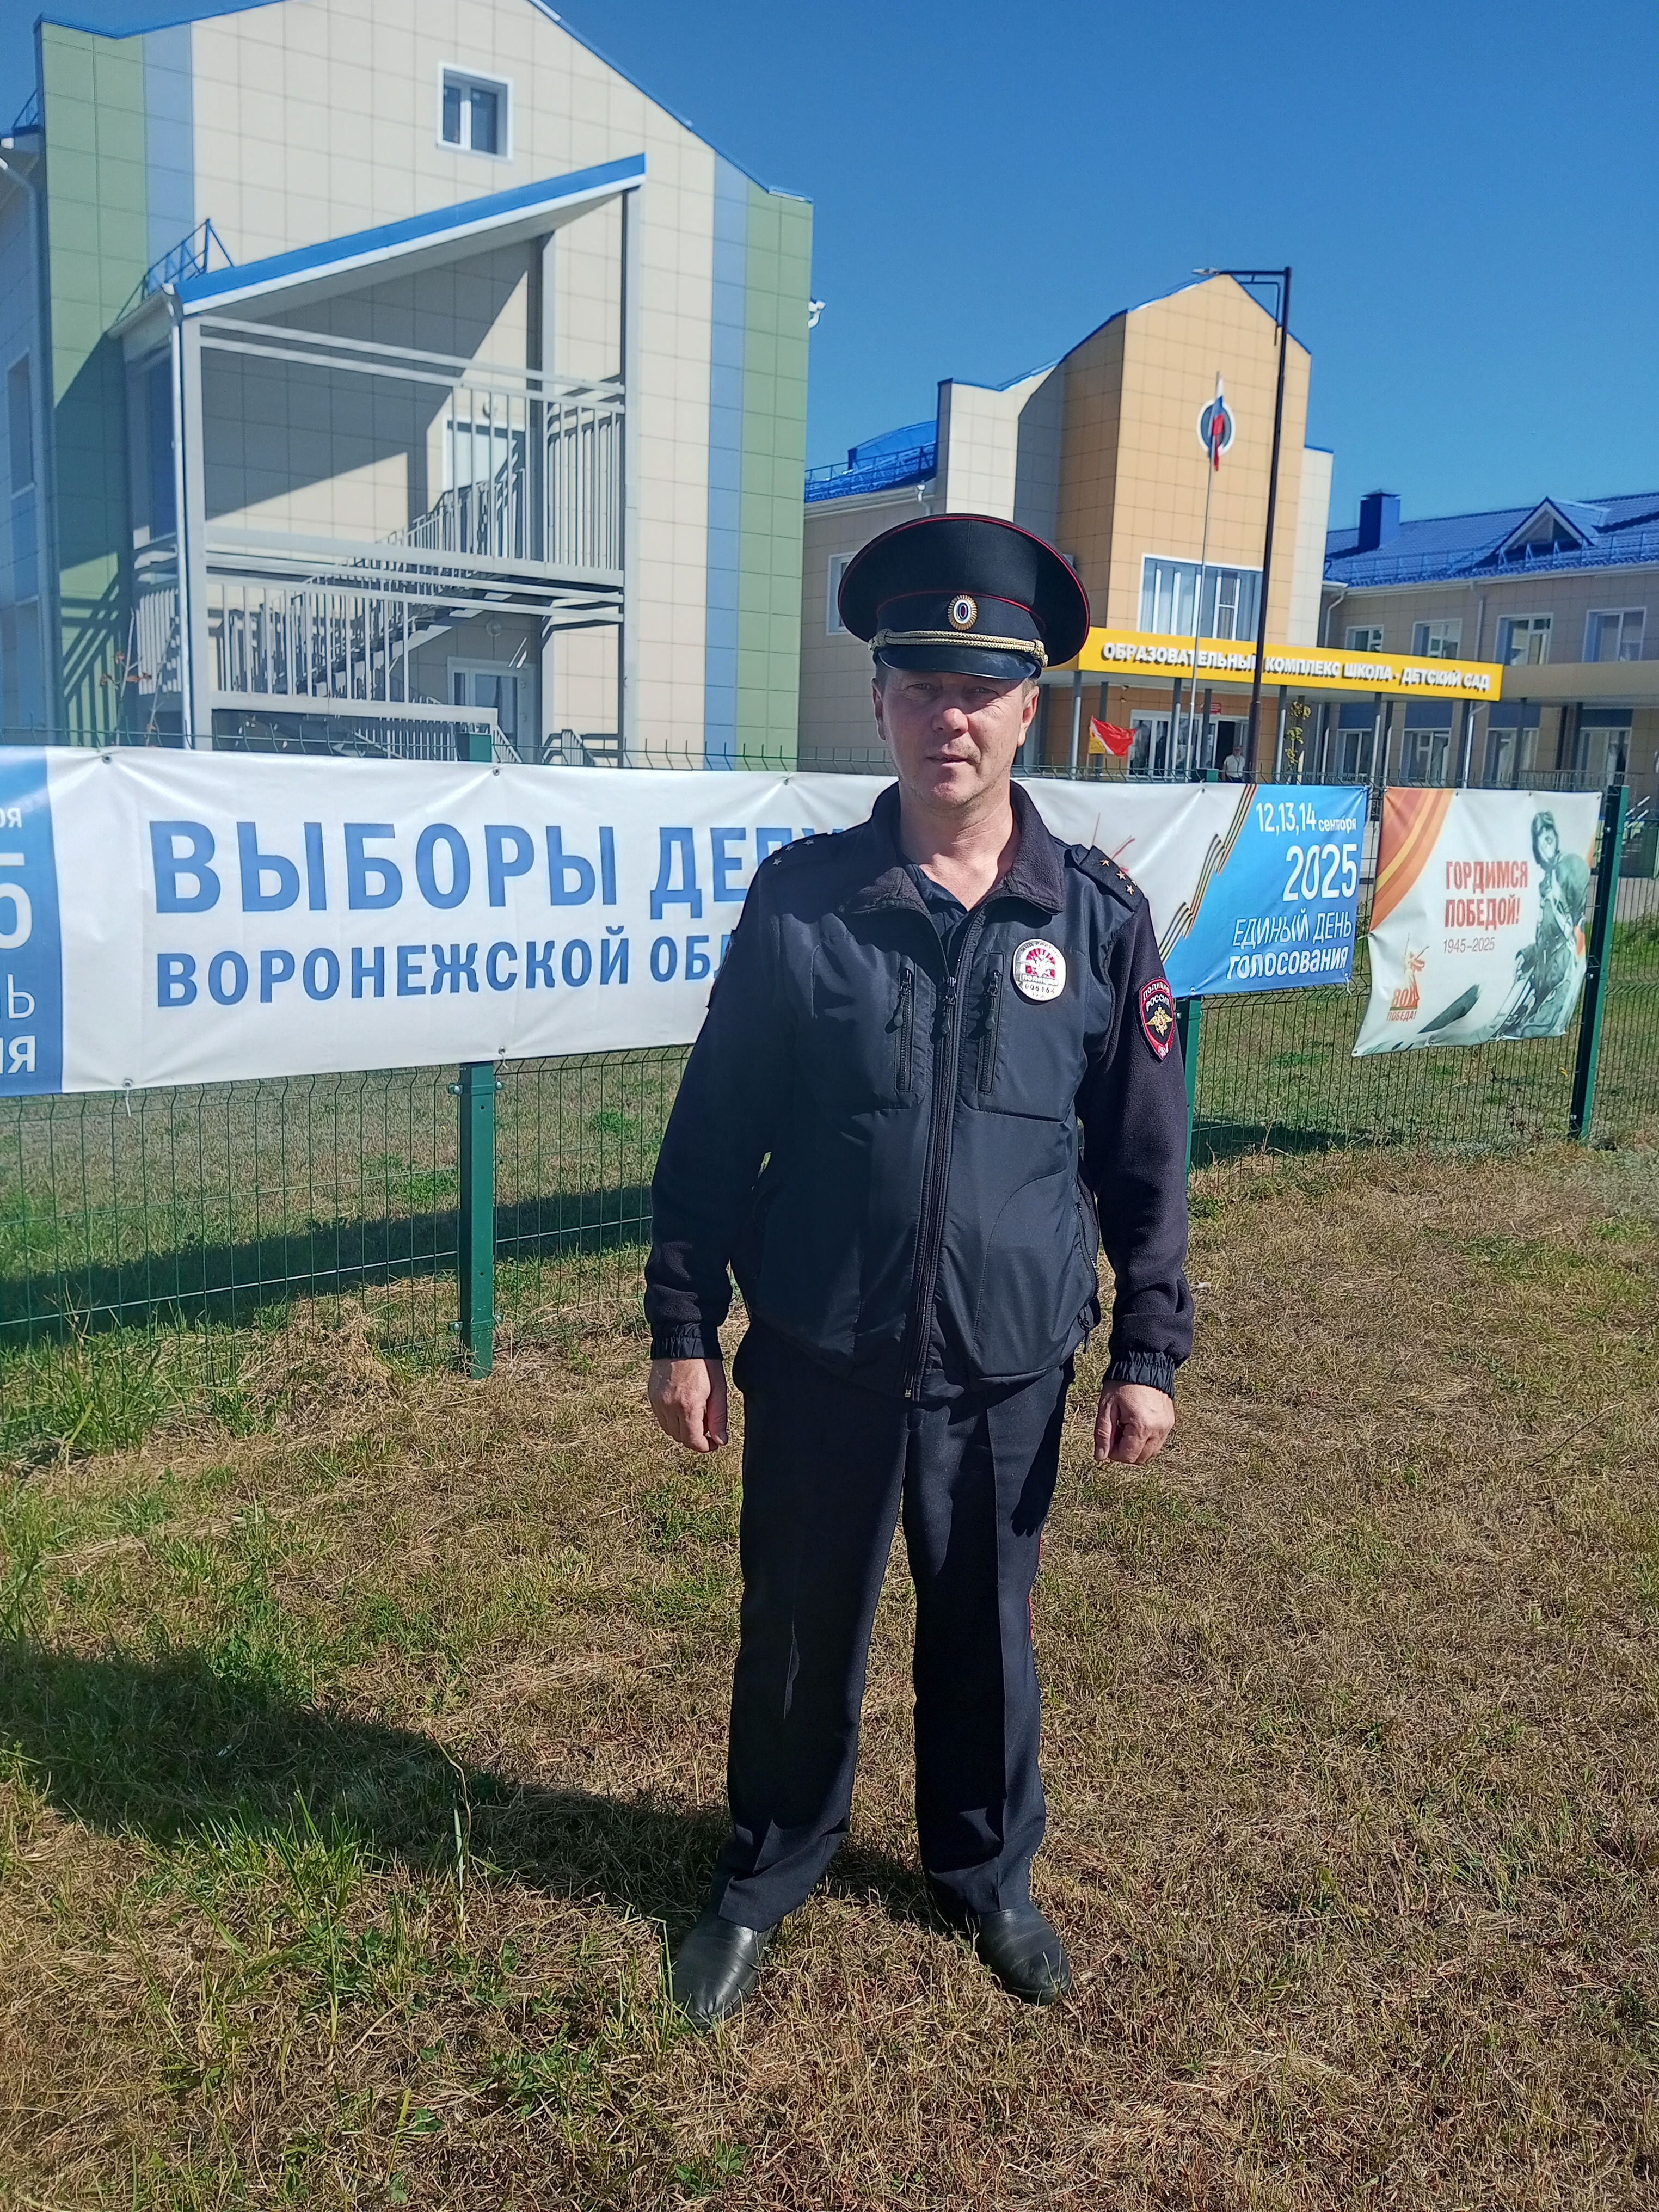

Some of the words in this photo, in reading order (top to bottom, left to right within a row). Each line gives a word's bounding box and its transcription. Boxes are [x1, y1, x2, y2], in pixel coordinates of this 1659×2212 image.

[1102, 642, 1256, 672] ОБРАЗОВАТЕЛЬНЫЙ
[1263, 656, 1341, 678] КОМПЛЕКС
[1342, 663, 1393, 681] ШКОЛА
[1399, 667, 1463, 687] ДЕТСКИЙ
[1463, 673, 1490, 692] САД
[1256, 802, 1317, 836] 12,13,14
[149, 821, 617, 913] ВЫБОРЫ
[1282, 843, 1358, 902] 2025
[1446, 860, 1529, 894] ГОРДИМСЯ
[1232, 908, 1309, 950] ЕДИНЫЙ
[1312, 911, 1352, 944] ДЕНЬ
[1445, 893, 1521, 931] ПОБЕДОЙ!
[157, 925, 630, 1009] ВОРОНЕЖСКОЙ
[1022, 974, 1058, 986] ПОЛИЦИЯ
[1143, 982, 1171, 1001] ПОЛИЦИЯ
[1146, 994, 1170, 1012] РОССИЯ
[1386, 1010, 1417, 1022] ПОБЕДА!
